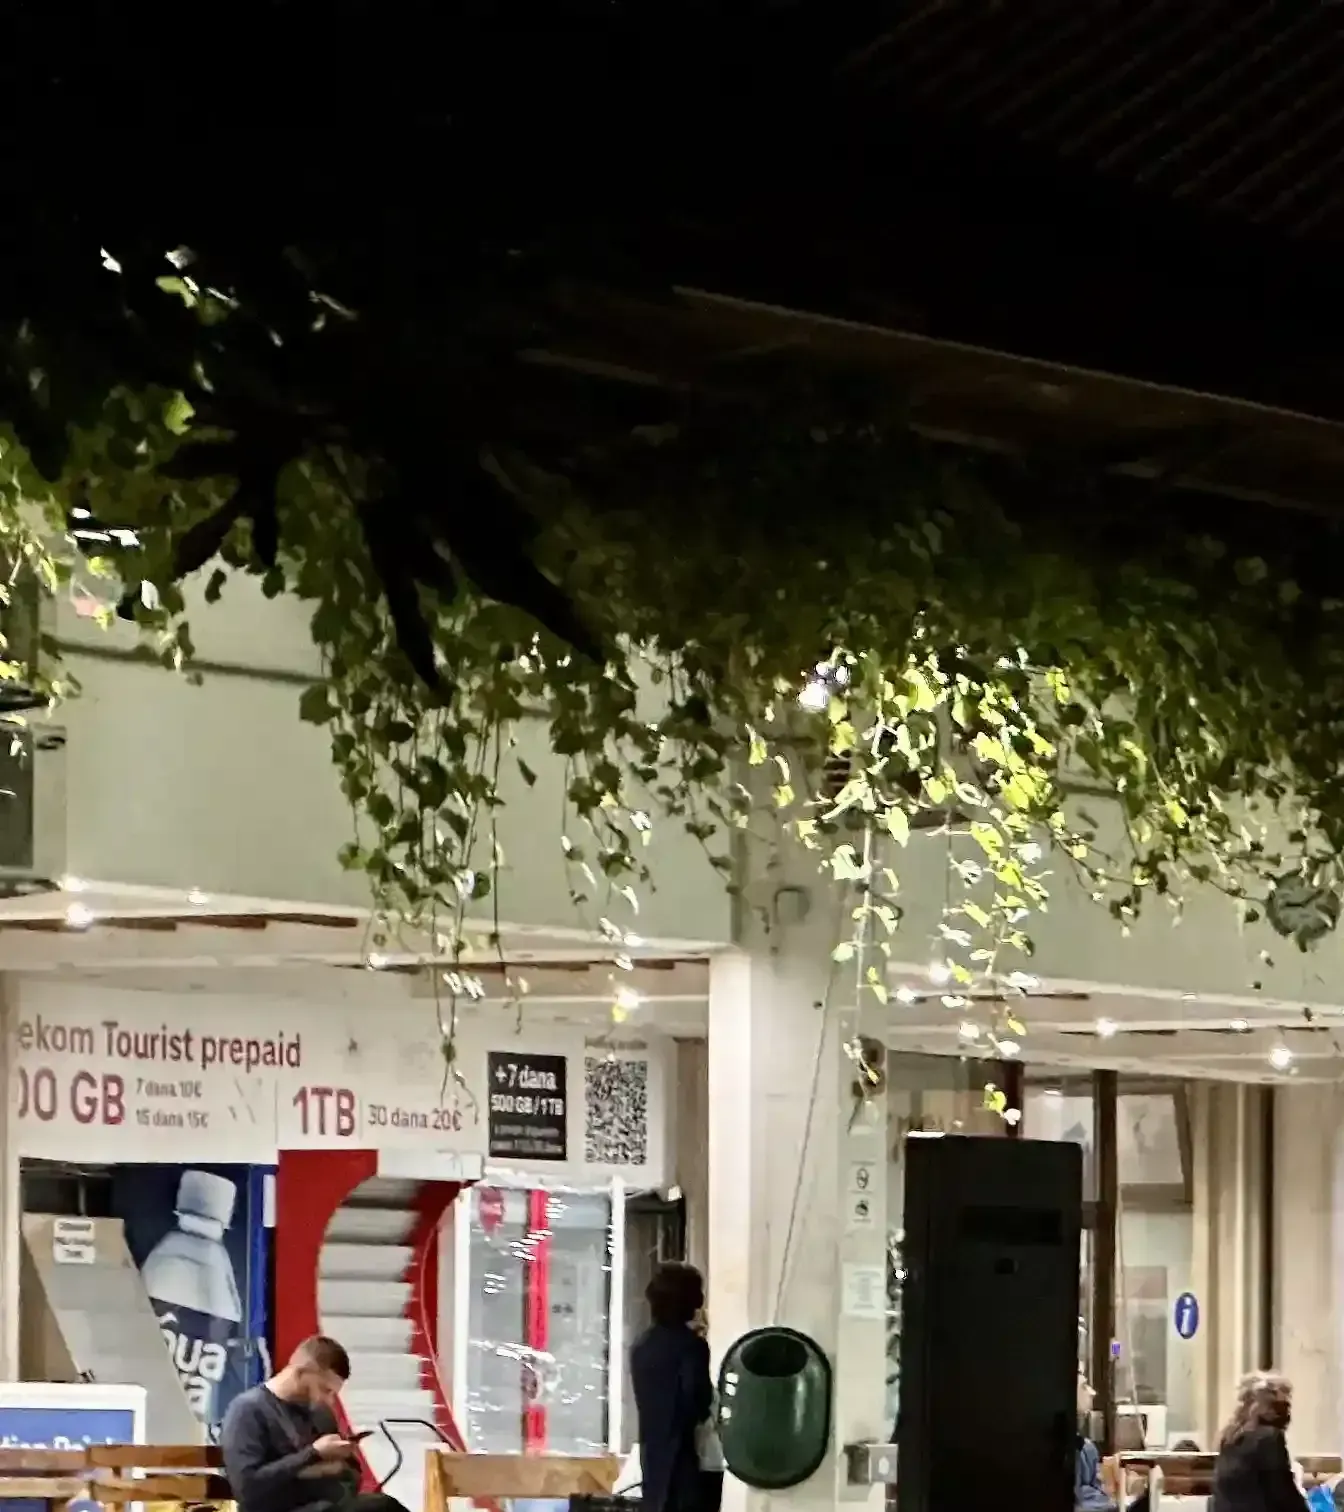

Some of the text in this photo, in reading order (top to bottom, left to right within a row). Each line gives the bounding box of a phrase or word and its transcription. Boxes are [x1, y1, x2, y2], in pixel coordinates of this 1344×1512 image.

[101, 1021, 194, 1061] Tourist
[201, 1031, 301, 1073] prepaid
[136, 1077, 144, 1095] 7
[519, 1065, 558, 1091] dana
[70, 1070, 125, 1125] GB
[293, 1085, 356, 1137] 1TB
[153, 1109, 184, 1128] dana
[367, 1104, 463, 1131] 30 dana 20€
